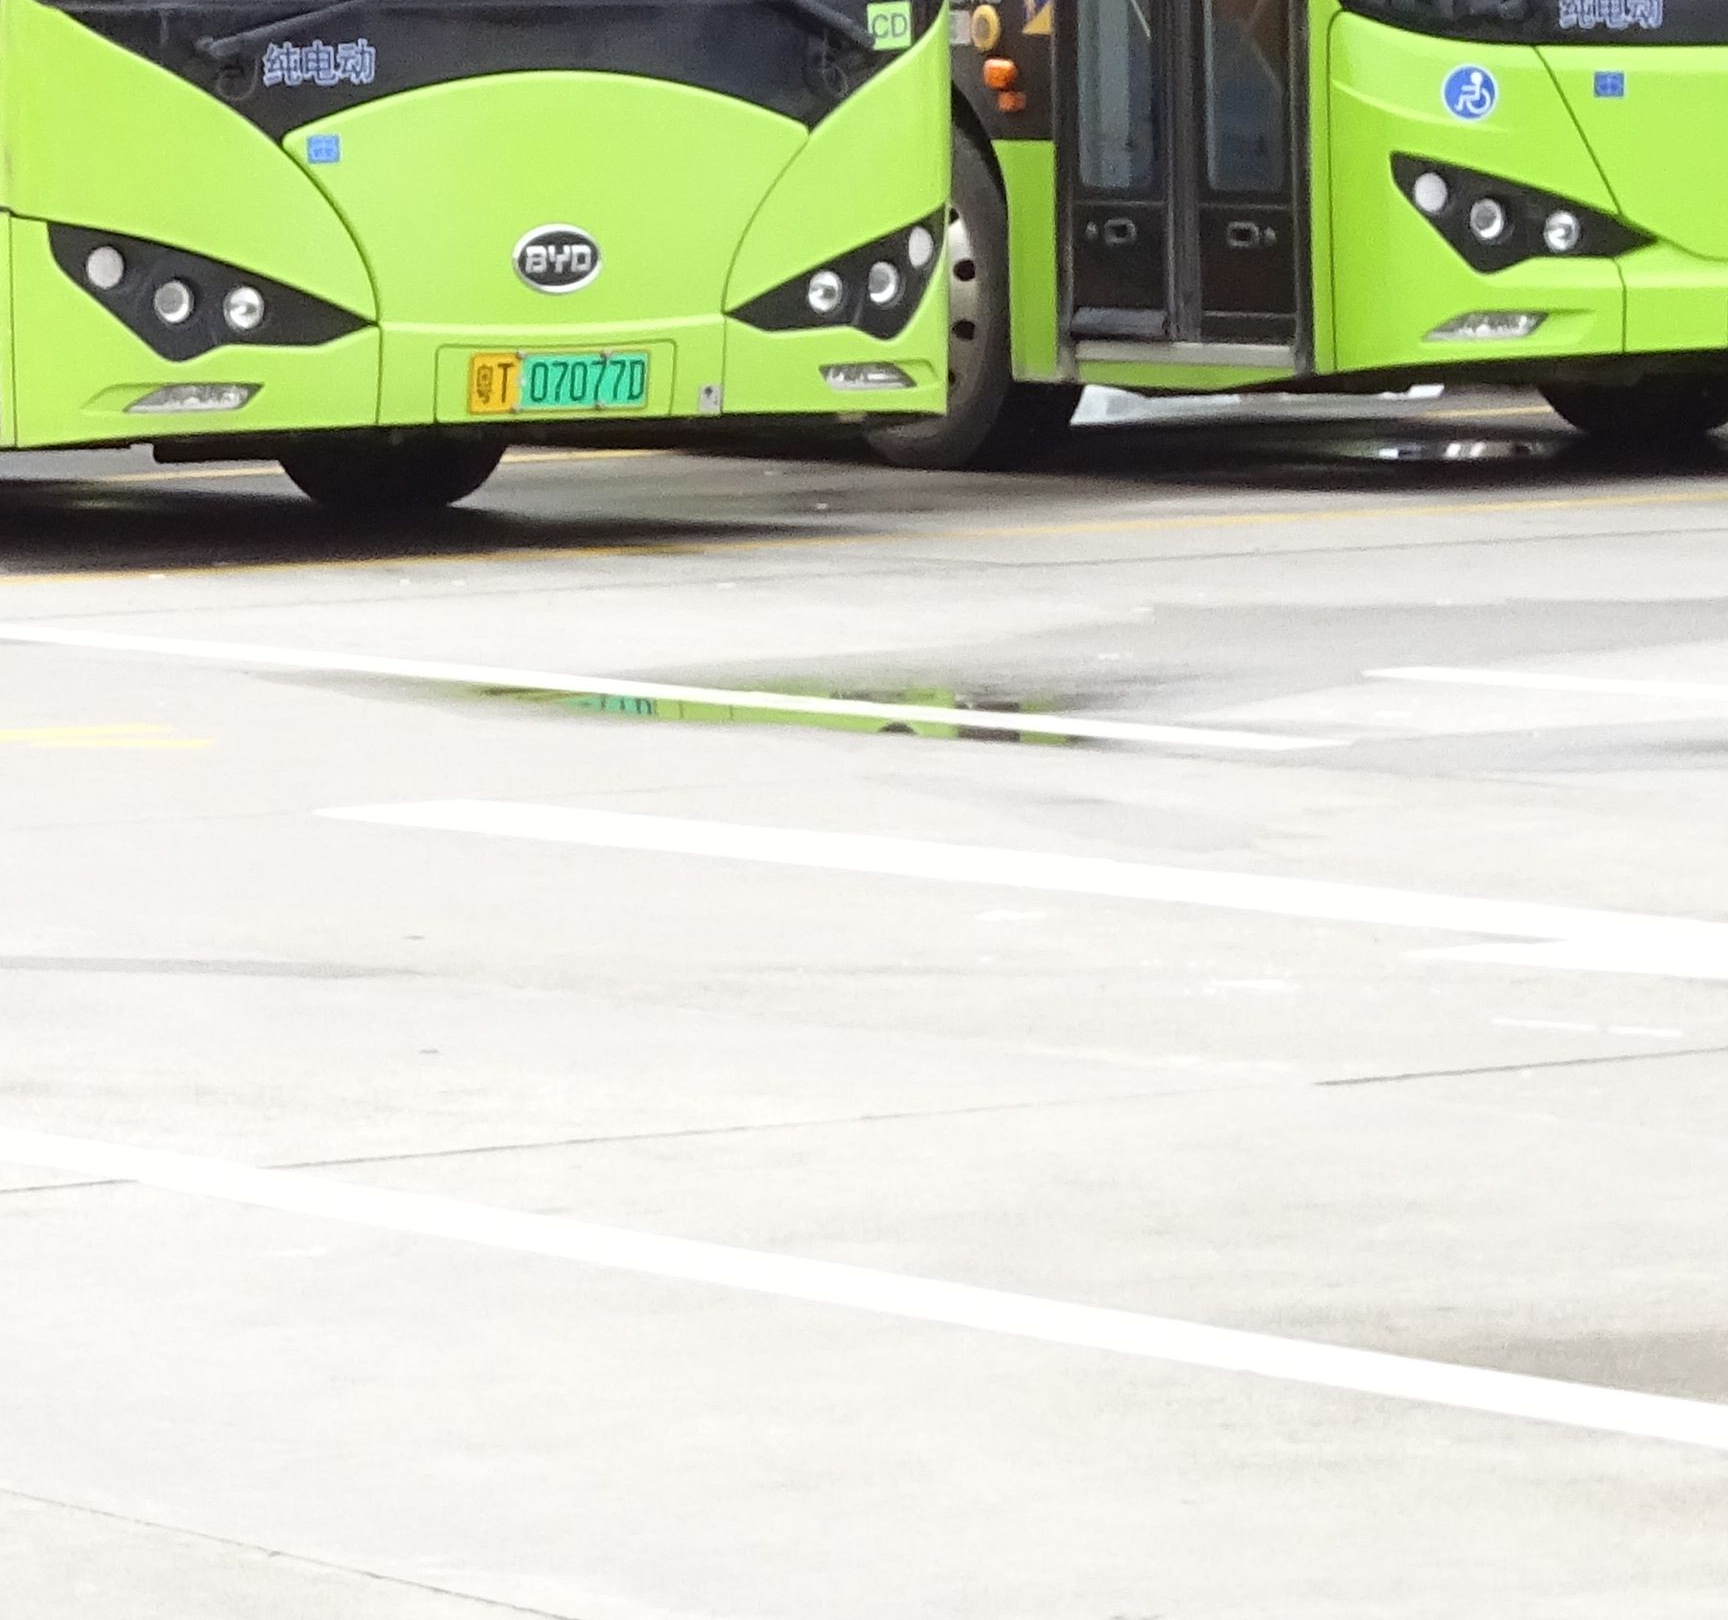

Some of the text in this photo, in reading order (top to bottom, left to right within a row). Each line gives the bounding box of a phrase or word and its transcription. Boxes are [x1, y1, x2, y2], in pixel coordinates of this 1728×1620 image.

[872, 13, 908, 39] CD
[263, 38, 376, 86] 纯电动
[524, 243, 592, 275] BYD
